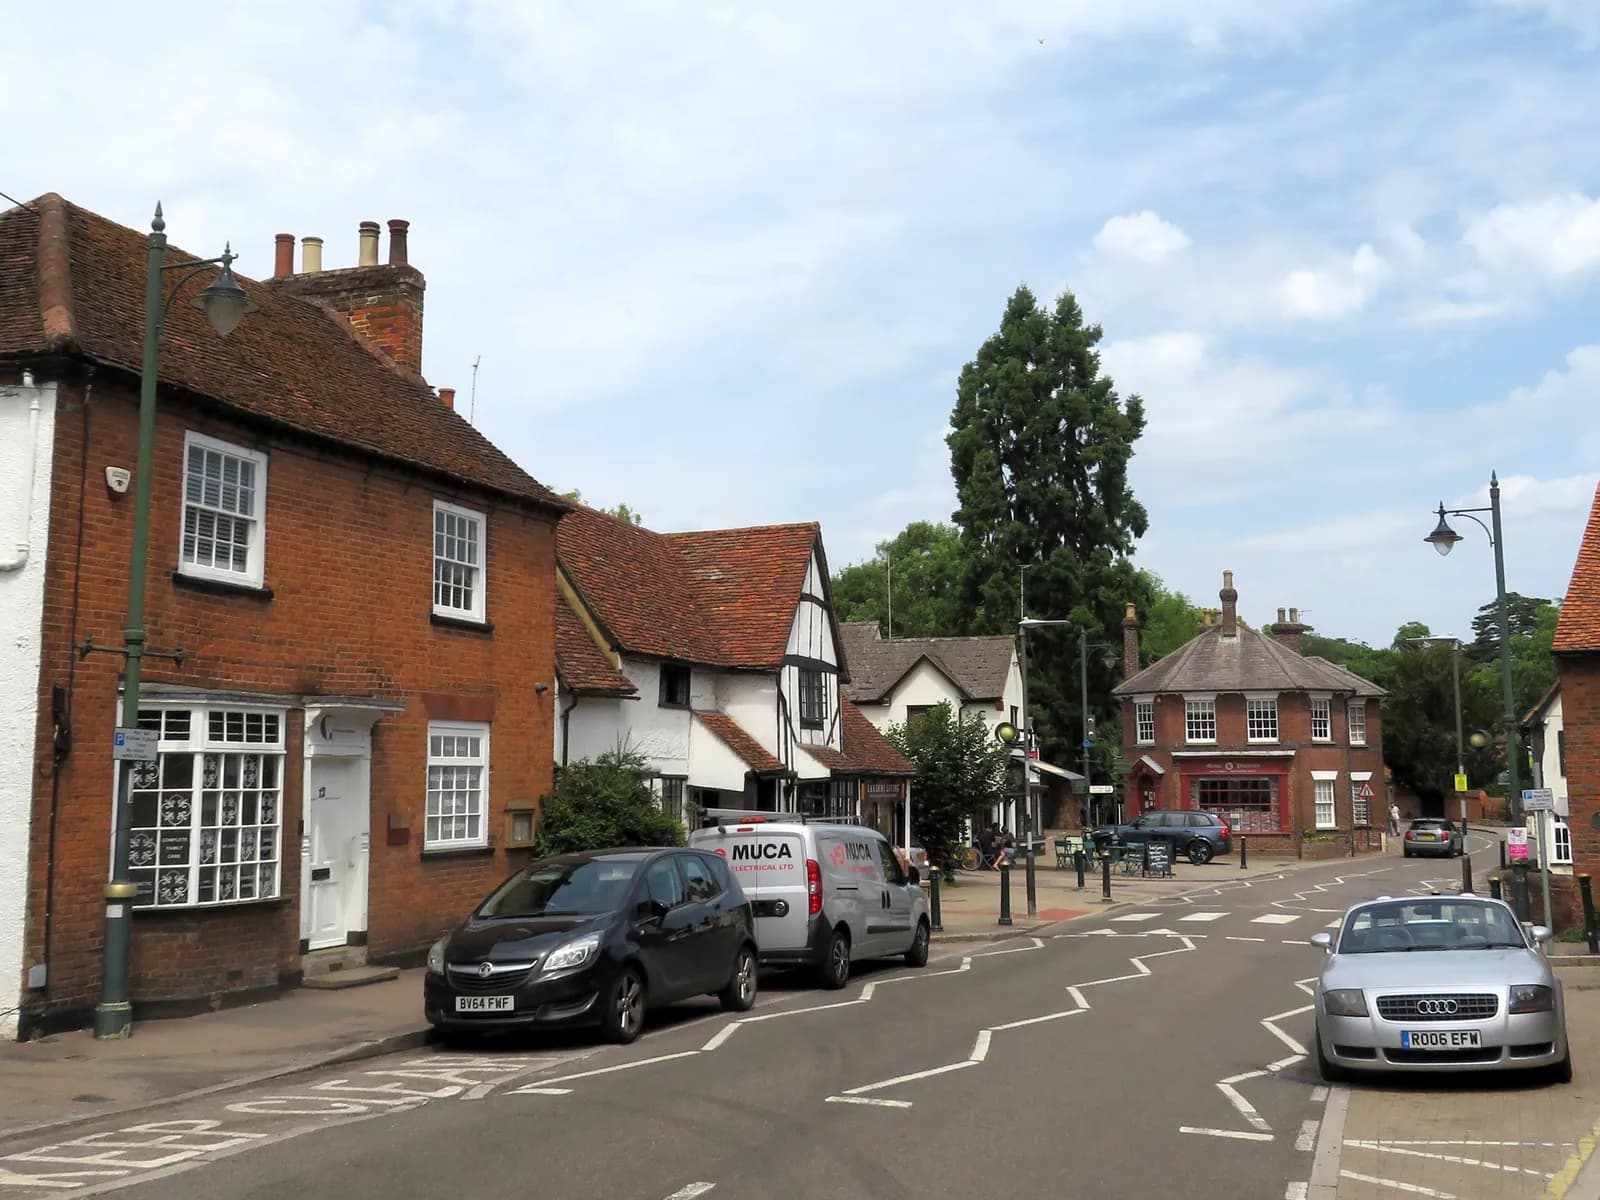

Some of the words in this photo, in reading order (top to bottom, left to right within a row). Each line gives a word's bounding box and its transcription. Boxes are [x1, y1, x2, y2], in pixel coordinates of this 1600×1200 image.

[732, 843, 792, 860] MUCA
[845, 842, 873, 861] MUCA
[780, 863, 795, 871] LTD
[460, 998, 486, 1010] BV64
[488, 997, 510, 1009] FWF
[1451, 1032, 1478, 1046] EFW
[226, 1056, 562, 1116] CLEAR
